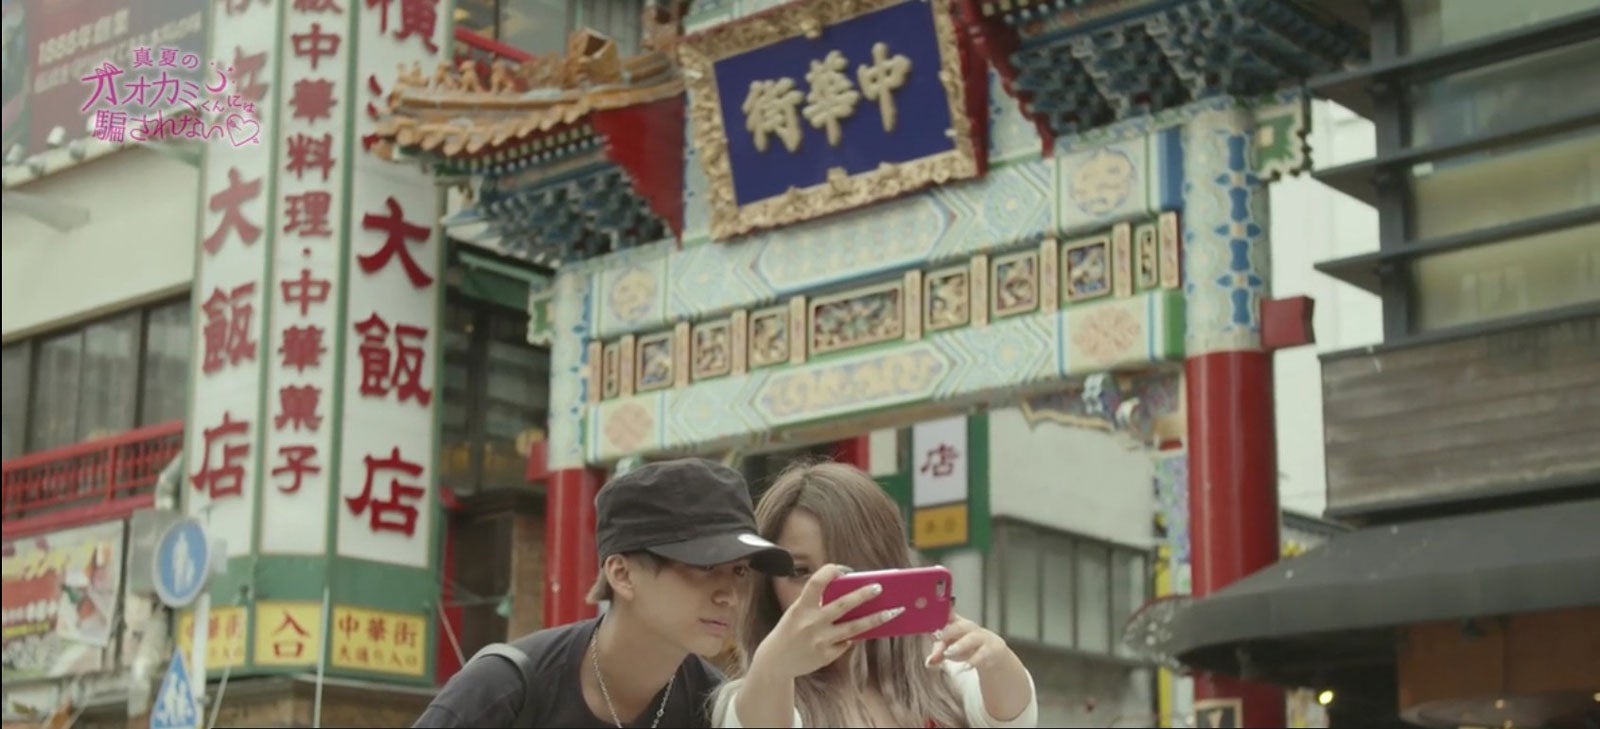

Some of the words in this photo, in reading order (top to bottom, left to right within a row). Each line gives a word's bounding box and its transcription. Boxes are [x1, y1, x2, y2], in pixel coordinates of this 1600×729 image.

[741, 41, 912, 152] 中華街
[272, 610, 311, 658] 入口
[338, 611, 418, 649] 中華街
